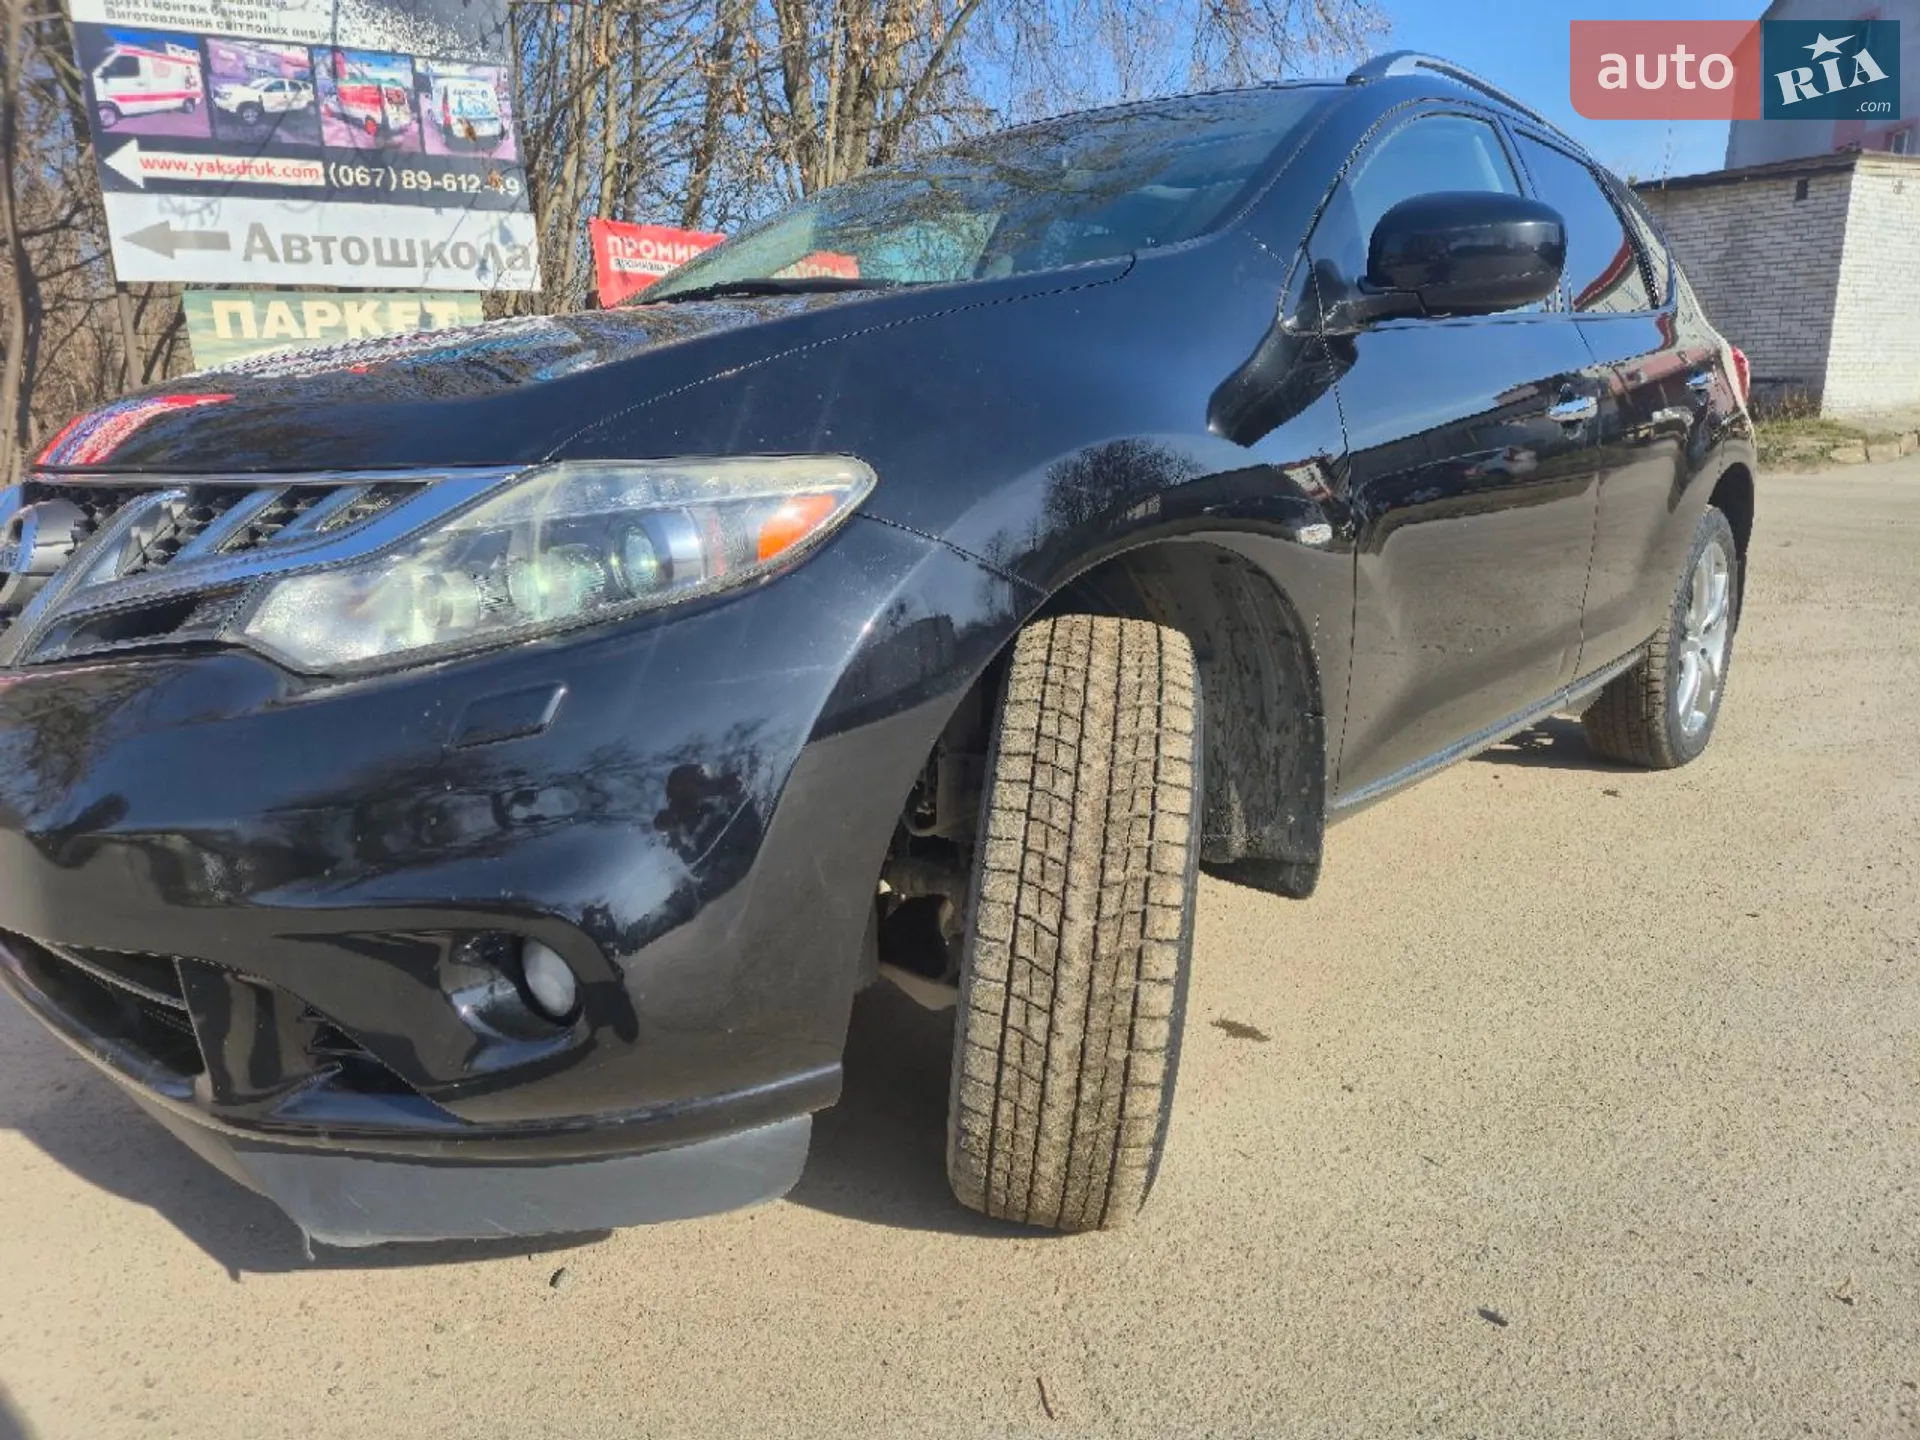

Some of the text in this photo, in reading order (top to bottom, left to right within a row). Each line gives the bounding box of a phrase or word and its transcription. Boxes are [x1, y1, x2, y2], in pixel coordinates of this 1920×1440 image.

[139, 156, 319, 180] www.yaksdruk.com
[243, 222, 531, 271] Автошкола
[211, 299, 459, 339] ПАРКЕТ
